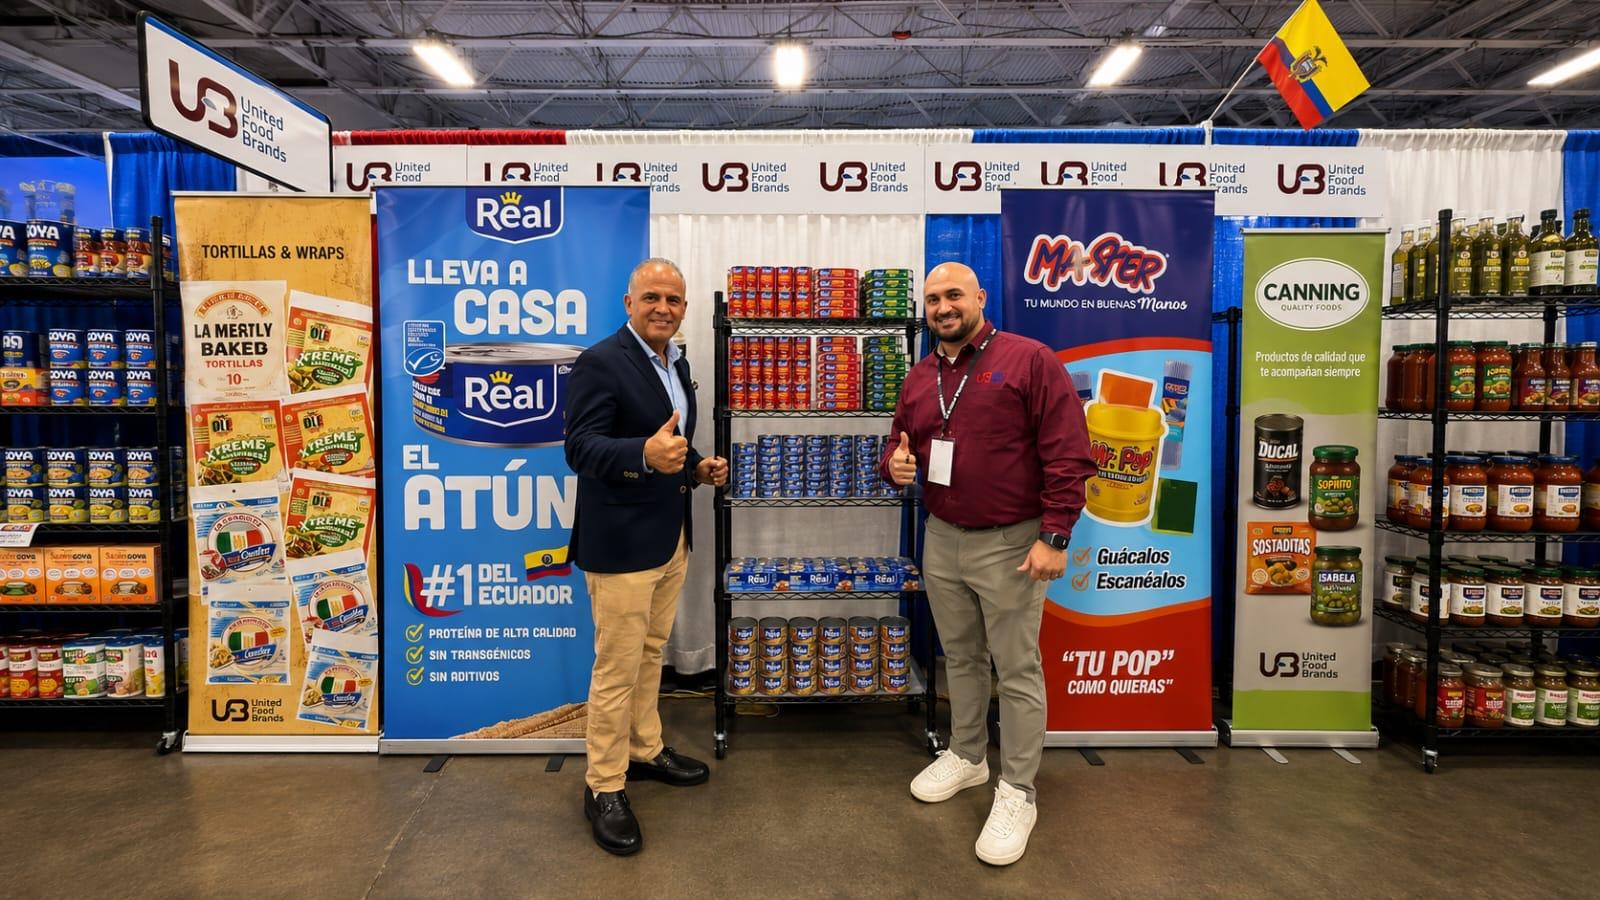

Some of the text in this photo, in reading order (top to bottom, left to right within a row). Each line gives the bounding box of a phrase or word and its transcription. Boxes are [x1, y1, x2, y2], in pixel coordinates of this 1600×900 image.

[240, 96, 284, 132] United
[242, 114, 274, 142] Food
[242, 130, 287, 163] Brands
[395, 162, 430, 173] United
[534, 162, 568, 173] United
[643, 162, 677, 173] United
[751, 162, 787, 173] United
[870, 161, 906, 172] United
[985, 161, 1020, 172] United
[1091, 161, 1127, 172] United
[1210, 162, 1245, 173] United
[1328, 164, 1364, 175] United
[395, 172, 422, 183] Food
[534, 172, 560, 183] Food
[644, 172, 671, 183] Food
[751, 172, 778, 183] Food
[870, 172, 896, 183] Food
[985, 171, 1010, 182] Food
[1091, 171, 1117, 182] Food
[1210, 172, 1236, 184] Food
[1328, 174, 1355, 185] Food
[651, 182, 681, 193] rands
[751, 182, 790, 193] Brands
[870, 182, 908, 193] Brands
[1212, 183, 1248, 194] rands
[1328, 185, 1367, 196] Brands
[477, 197, 551, 231] Real
[202, 245, 345, 260] TORTILLAS & WRAPS
[408, 259, 527, 285] LLEVA A
[1264, 283, 1360, 301] CANNING
[1025, 297, 1187, 312] TU MUNDO EN BUENAS Manos
[454, 289, 587, 336] CASA
[195, 324, 211, 338] LA
[201, 342, 268, 356] BAKED
[1256, 351, 1366, 364] Productos de calidad que
[206, 360, 263, 368] TORTILLAS
[1260, 366, 1361, 379] te acompañan siempre
[226, 374, 241, 385] 10
[465, 377, 544, 413] Real
[1258, 440, 1298, 459] DUCAL
[403, 445, 439, 470] EL
[404, 459, 578, 530] ATÚN
[1098, 548, 1169, 565] Guácalos
[478, 564, 518, 583] DEL
[1319, 574, 1355, 583] ISABELA
[420, 564, 472, 608] #1
[1096, 572, 1185, 590] Escanéalos
[478, 585, 573, 605] ECUADOR
[429, 627, 577, 639] PROTEÍNA DE ALTA CALIDAD
[429, 647, 531, 661] SIN TRANSGÉNICOS
[1302, 652, 1336, 661] United
[1302, 661, 1327, 669] Food
[429, 671, 500, 682] SIN ADITIVOS
[1302, 669, 1338, 678] Brands
[1068, 680, 1106, 694] COMO
[251, 699, 282, 707] United
[251, 707, 274, 715] Food
[251, 714, 284, 722] Brands
